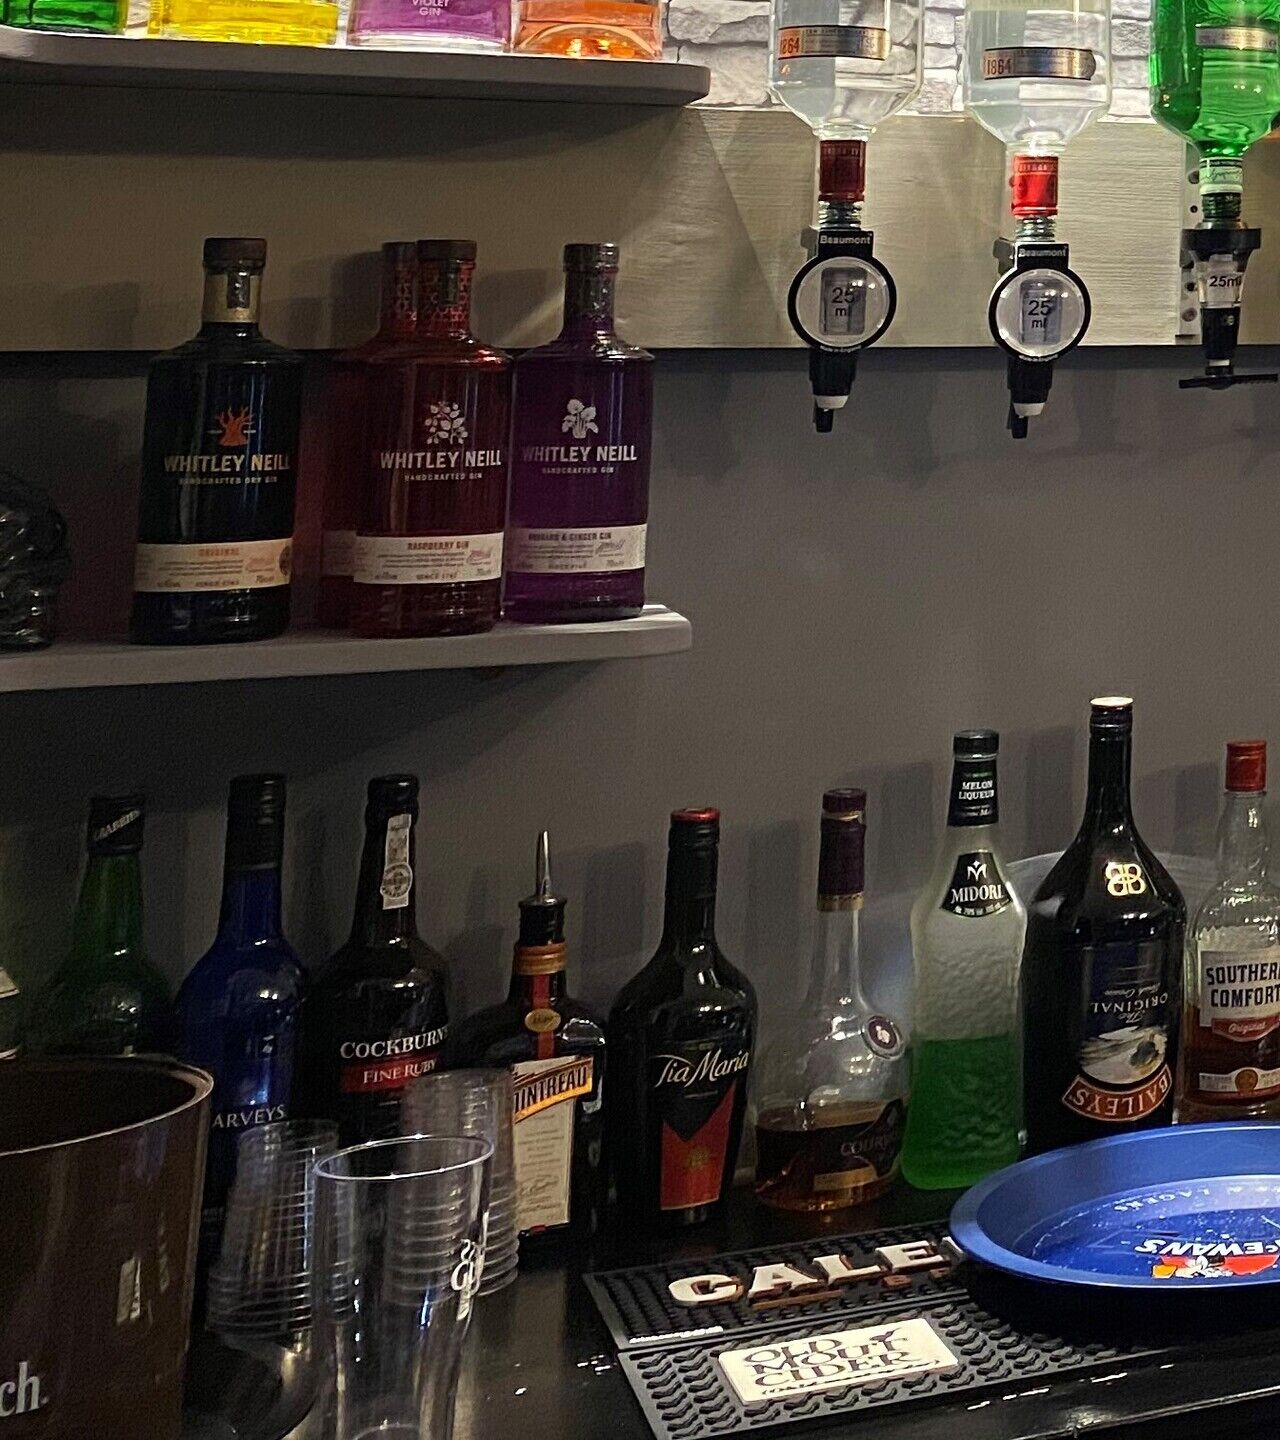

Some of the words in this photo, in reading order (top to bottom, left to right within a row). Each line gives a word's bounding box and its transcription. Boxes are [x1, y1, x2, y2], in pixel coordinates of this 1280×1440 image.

[419, 7, 441, 17] GIN
[779, 36, 800, 55] 1864
[986, 58, 1013, 75] 1864
[820, 235, 871, 245] Beaumont
[1018, 247, 1067, 258] Beaumont
[831, 286, 856, 304] 25
[1028, 299, 1052, 316] 25
[1031, 317, 1048, 329] ml
[163, 453, 246, 473] WHITLEY
[250, 453, 290, 472] NEILL
[380, 451, 460, 469] WHITLEY
[464, 449, 502, 468] NEILL
[522, 446, 592, 463] WHITLEY
[596, 445, 638, 462] NEILL
[404, 473, 466, 482] HANDCRAFTED
[468, 472, 483, 480] GIN
[542, 467, 598, 475] HANDCRAFTED
[600, 466, 614, 474] GIN
[407, 541, 454, 551] RASPBERRY
[455, 540, 470, 549] GIN
[569, 533, 597, 541] GINGER
[600, 532, 612, 540] GIN
[961, 779, 994, 790] MELON
[950, 883, 1004, 905] MIDORI
[1089, 991, 1169, 1014] ORIGINAL
[1117, 1009, 1146, 1024] The
[1227, 1020, 1267, 1035] Original
[363, 1065, 402, 1084] FINE
[403, 1058, 437, 1078] RUBY
[654, 1054, 692, 1089] Tia
[688, 1047, 750, 1088] Maria
[1071, 1073, 1169, 1118] BAILEYS
[1112, 1187, 1210, 1213] LAGERS
[743, 1338, 845, 1364] OLD
[748, 1336, 908, 1375] MOUT
[754, 1350, 923, 1388] CIDER
